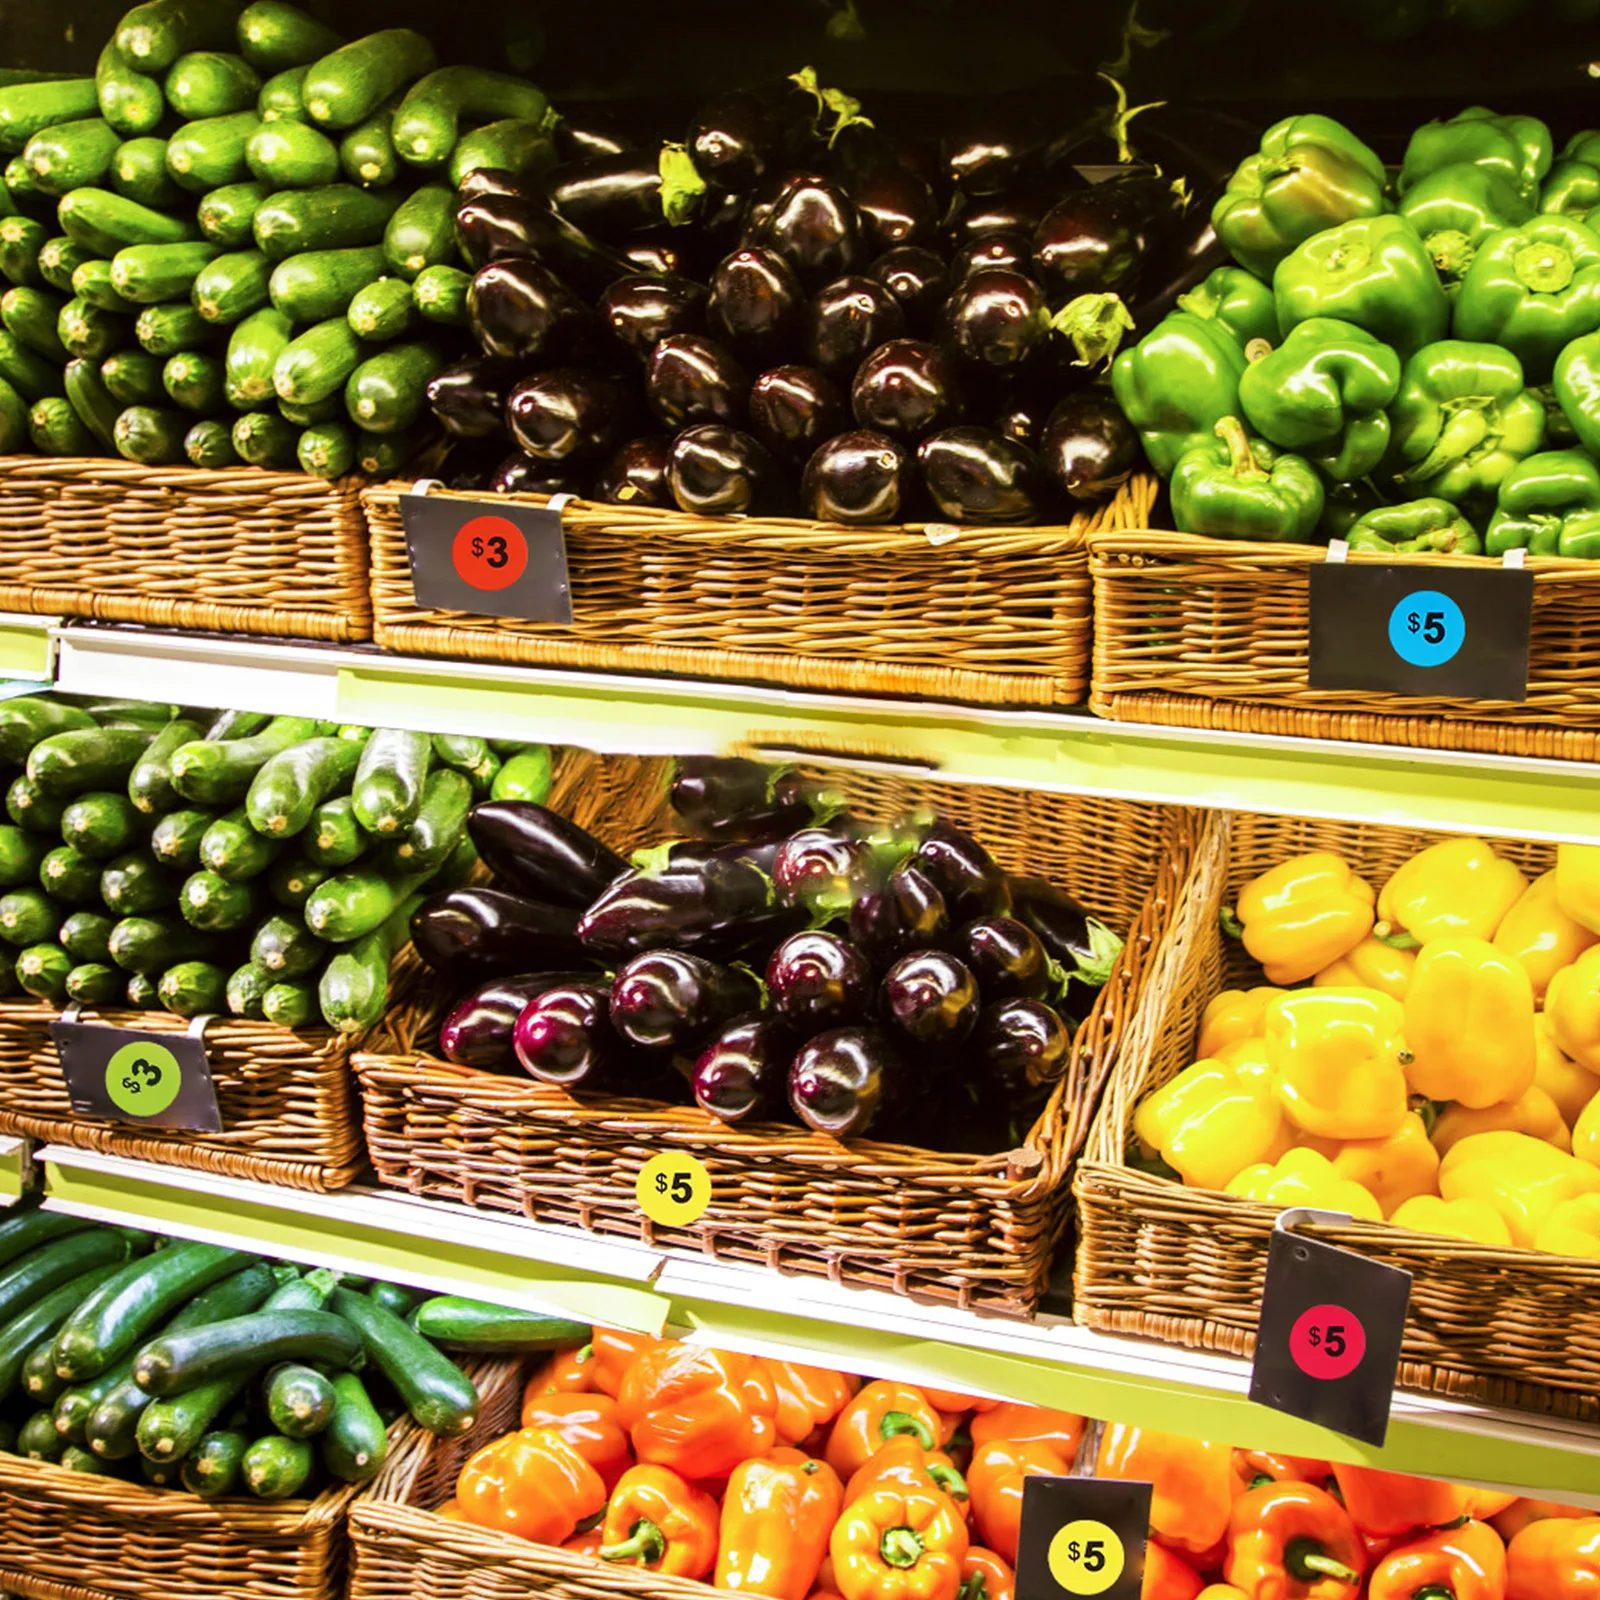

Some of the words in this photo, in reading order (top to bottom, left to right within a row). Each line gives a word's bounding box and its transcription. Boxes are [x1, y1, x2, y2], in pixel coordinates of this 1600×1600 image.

[471, 536, 509, 569] $3
[1407, 611, 1446, 644] $5
[122, 1058, 162, 1094] $3
[655, 1172, 693, 1204] $5
[1308, 1325, 1346, 1357] $5
[1068, 1540, 1106, 1572] $5
